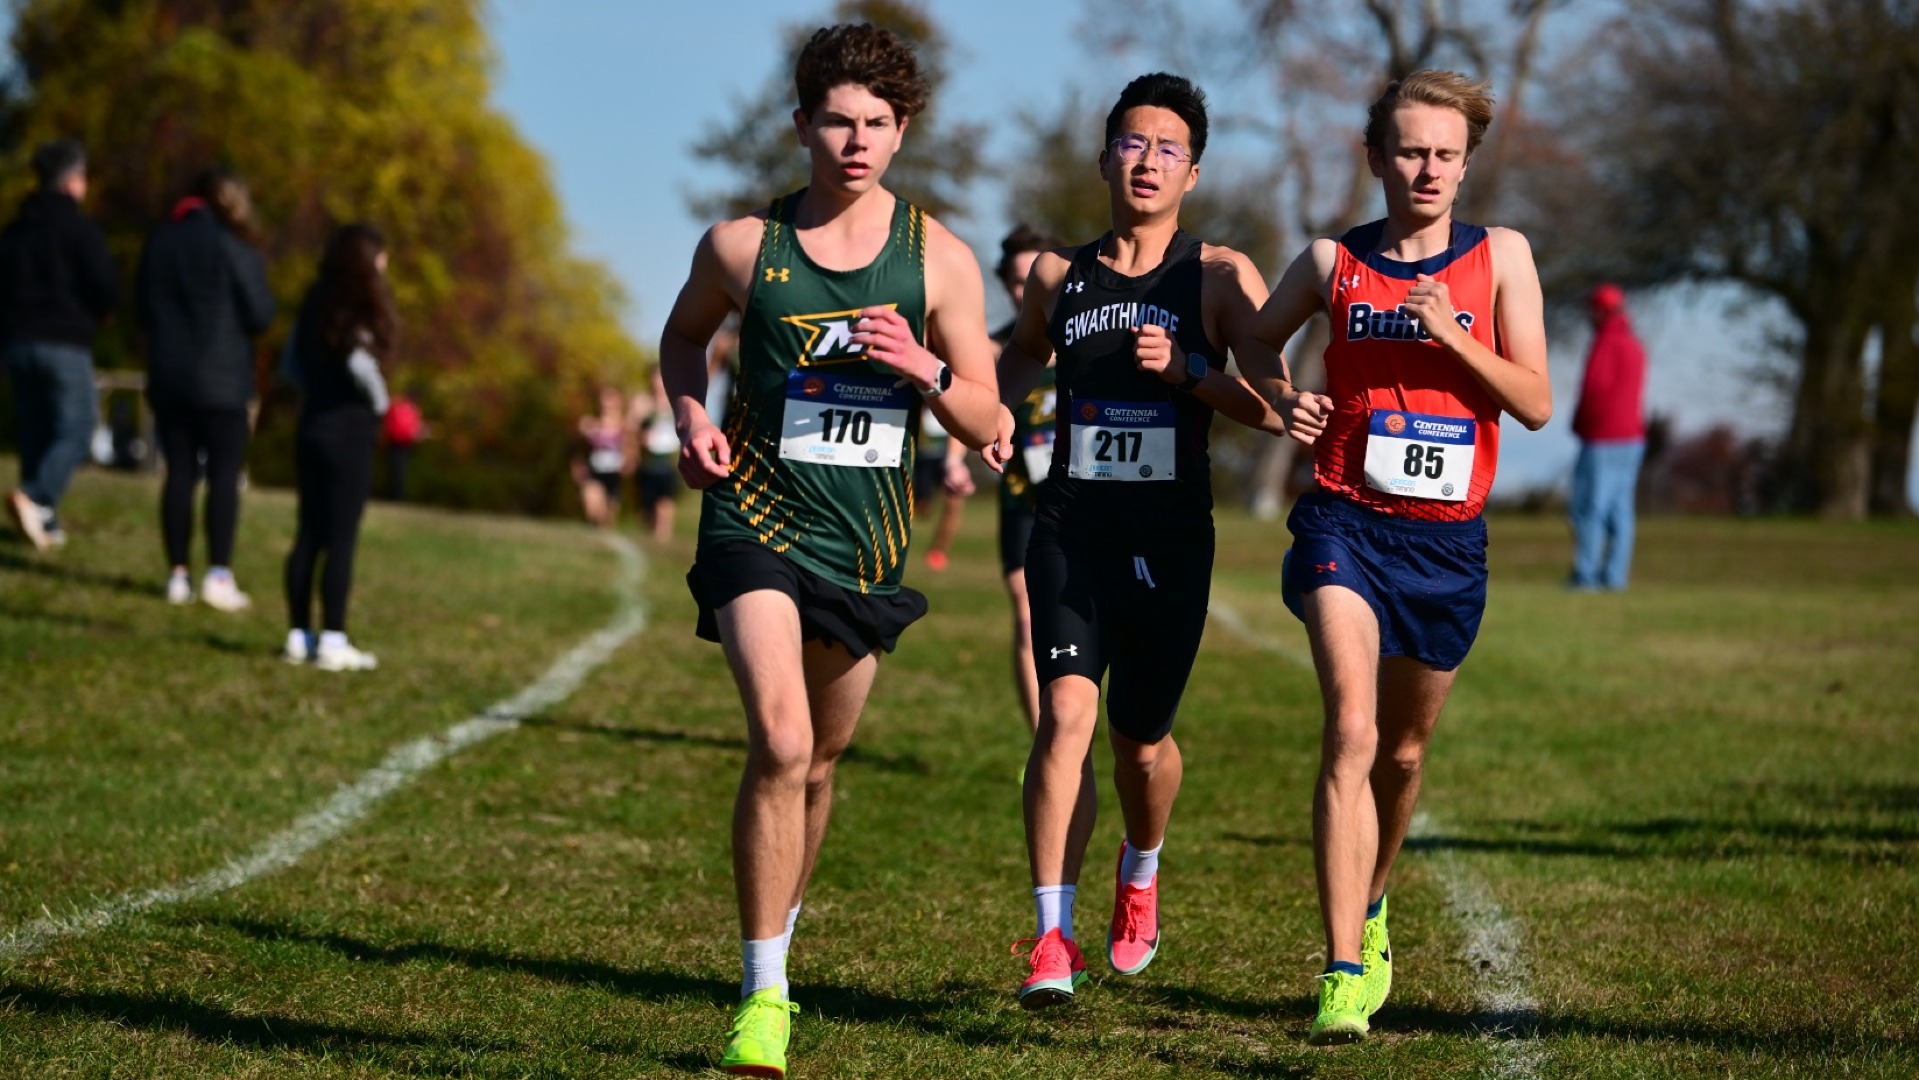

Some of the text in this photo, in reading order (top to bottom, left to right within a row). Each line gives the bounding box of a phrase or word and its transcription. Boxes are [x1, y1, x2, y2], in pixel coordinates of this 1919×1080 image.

[1065, 302, 1179, 346] SWARTHMORE
[1104, 407, 1159, 417] CENTENNIAL
[1109, 415, 1151, 423] CONFERENCE
[818, 408, 872, 445] 170
[1412, 420, 1468, 433] CENTENNIAL
[1418, 429, 1461, 439] CONFERENCE
[1095, 429, 1143, 463] 217
[1403, 443, 1445, 479] 85
